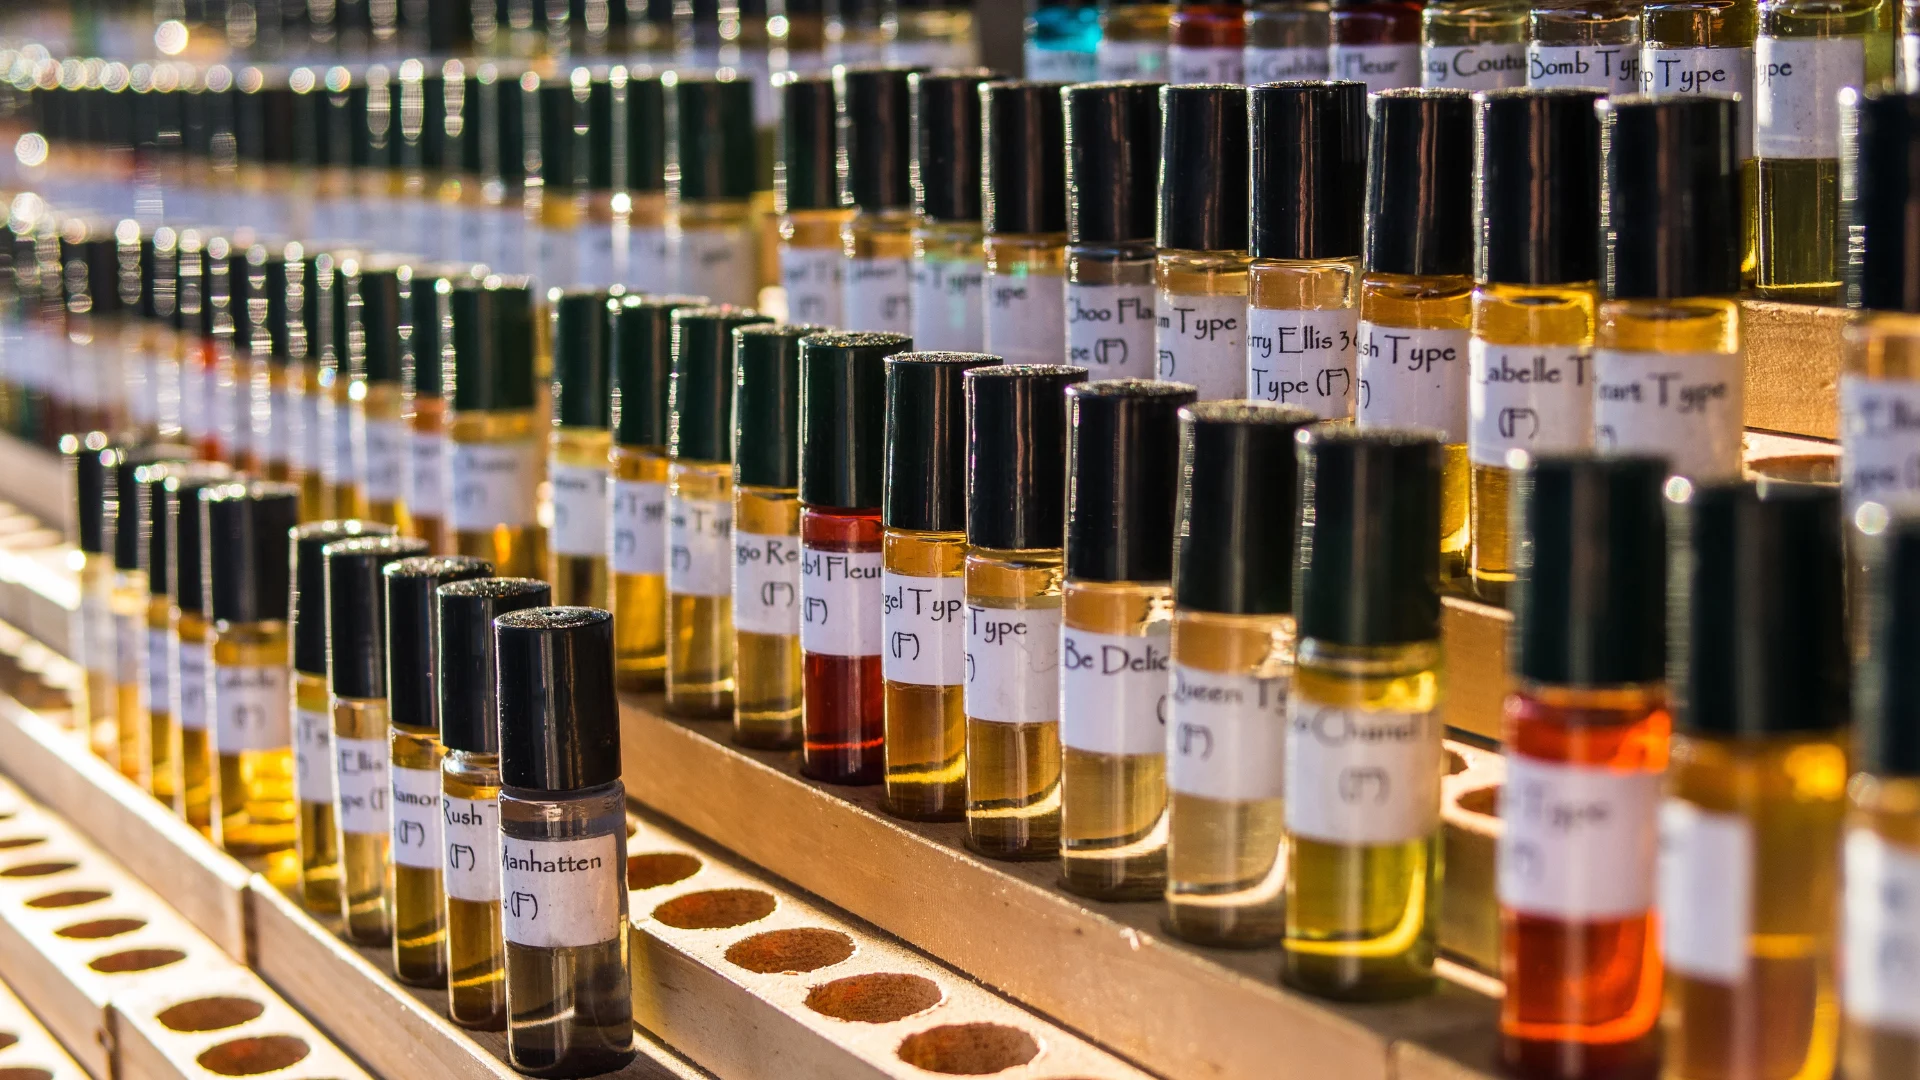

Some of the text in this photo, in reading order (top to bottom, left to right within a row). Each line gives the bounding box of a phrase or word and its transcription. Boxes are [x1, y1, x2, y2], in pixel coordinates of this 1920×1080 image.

[1530, 51, 1590, 80] Bomb
[1657, 59, 1726, 93] Type
[1174, 307, 1238, 341] Type
[1094, 338, 1129, 365] (F)
[1278, 325, 1333, 354] Ellis
[1384, 334, 1457, 373] Type
[1252, 367, 1350, 403] Type (F)
[1498, 406, 1541, 440] (F)
[760, 580, 795, 607] (F)
[907, 587, 962, 623] Typ
[805, 595, 828, 625] (F)
[968, 605, 1028, 646] Type
[891, 631, 920, 661] (F)
[400, 819, 425, 849] (F)
[450, 843, 475, 872] (F)
[511, 890, 538, 921] (F)
